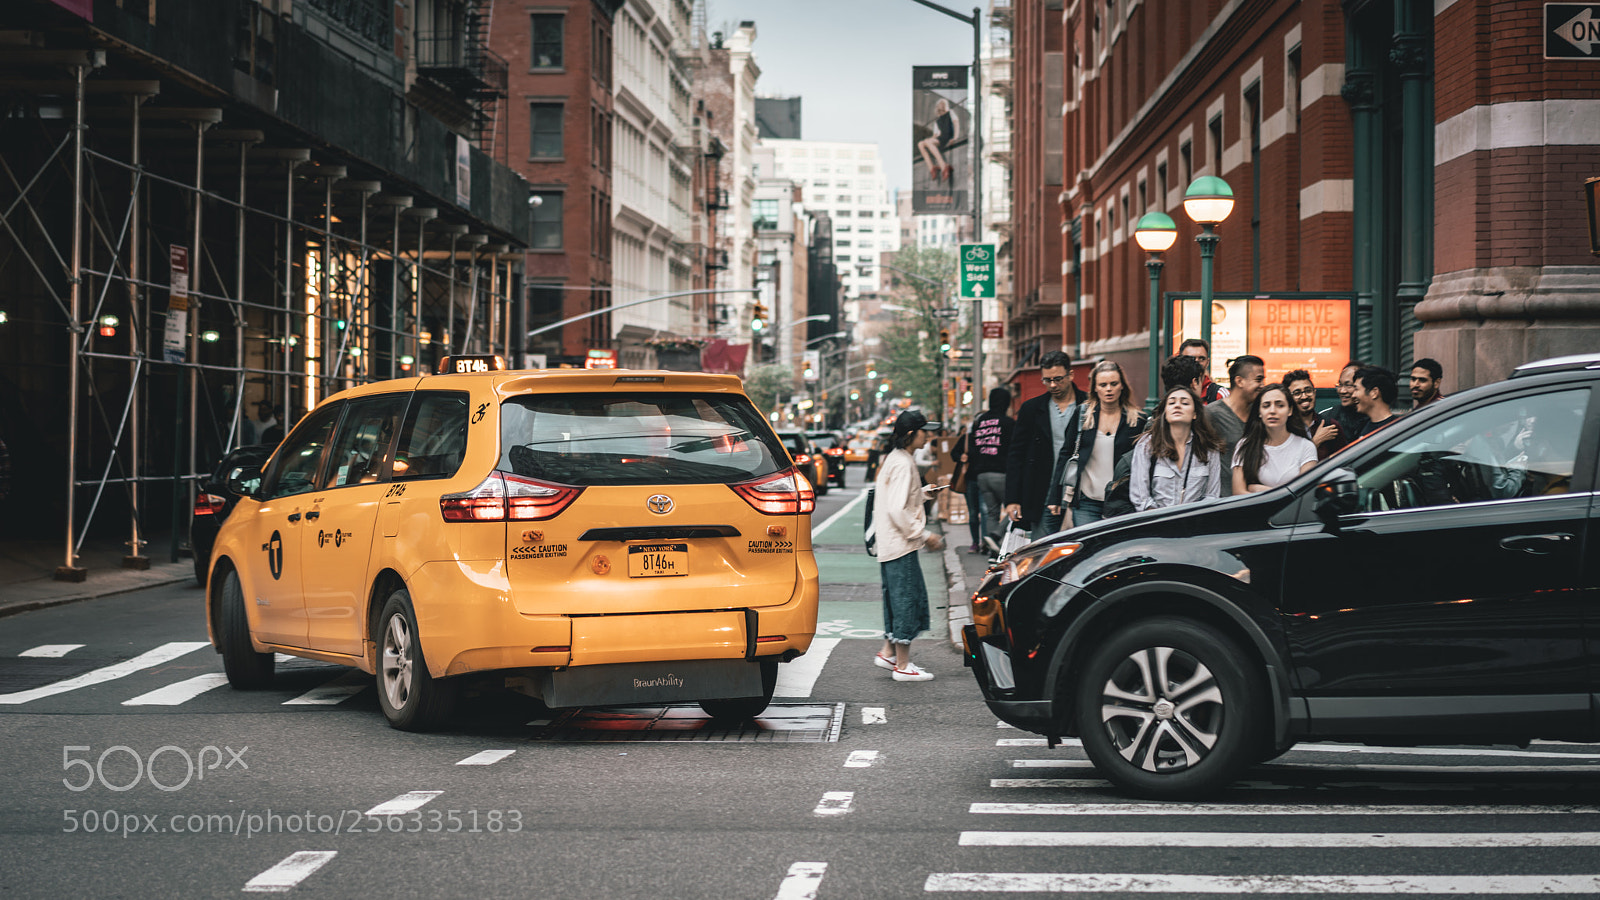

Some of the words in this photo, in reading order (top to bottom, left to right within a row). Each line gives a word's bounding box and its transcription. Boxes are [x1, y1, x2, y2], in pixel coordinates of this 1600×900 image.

[966, 264, 989, 272] West
[966, 273, 989, 281] Side
[1267, 303, 1334, 324] BELIEVE
[1260, 326, 1292, 346] THE
[1296, 326, 1339, 346] HYPE
[456, 360, 488, 373] 8T46
[538, 544, 568, 553] CAUTION
[748, 540, 773, 548] CAUTION
[643, 554, 675, 570] 8T46H
[633, 677, 684, 688] BraunAbility
